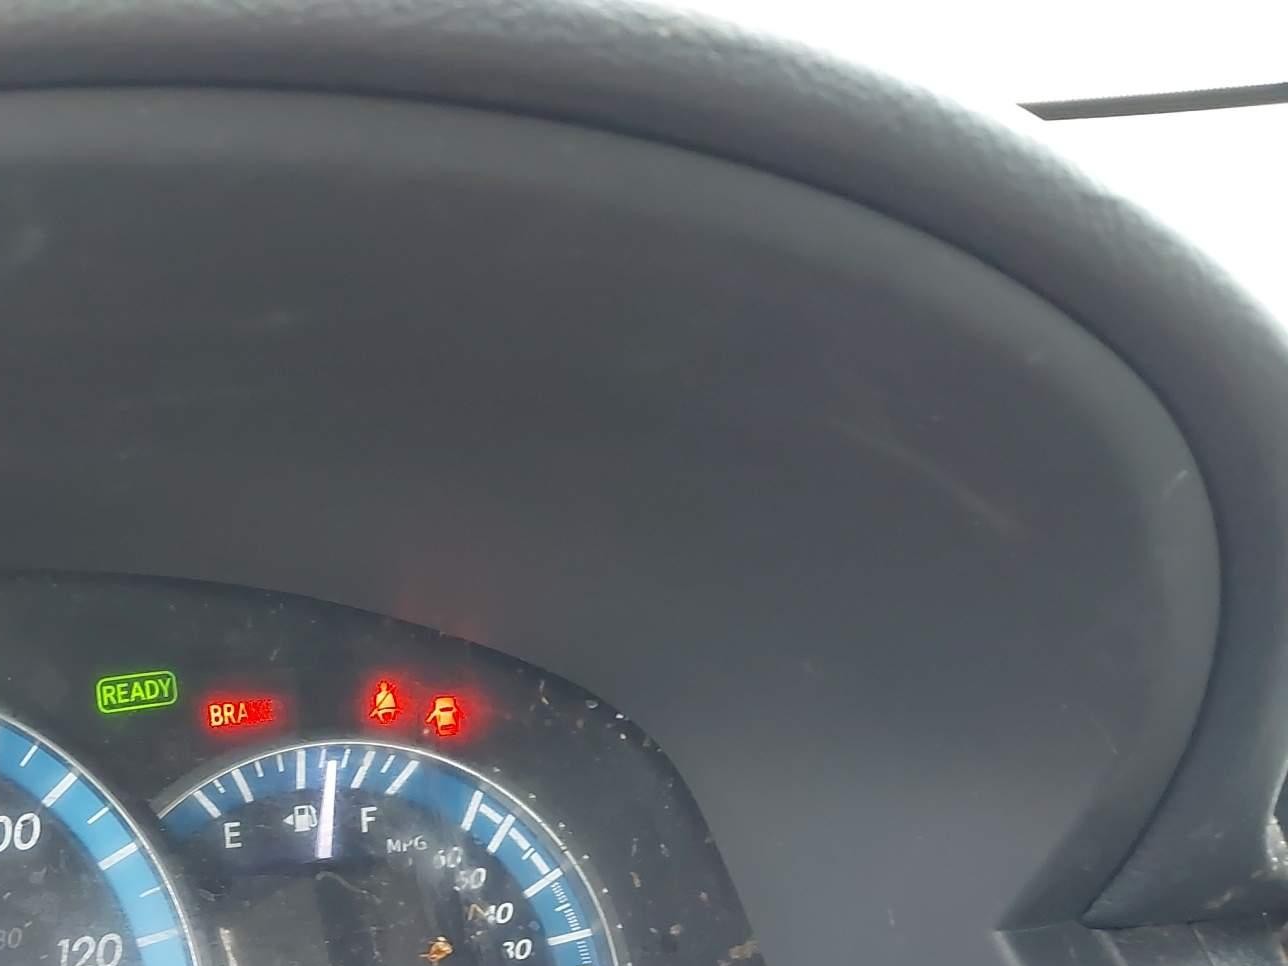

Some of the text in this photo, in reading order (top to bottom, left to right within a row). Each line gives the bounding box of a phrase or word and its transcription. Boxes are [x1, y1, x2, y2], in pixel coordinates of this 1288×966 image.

[101, 678, 172, 707] READY
[360, 807, 377, 833] F
[225, 822, 242, 848] E
